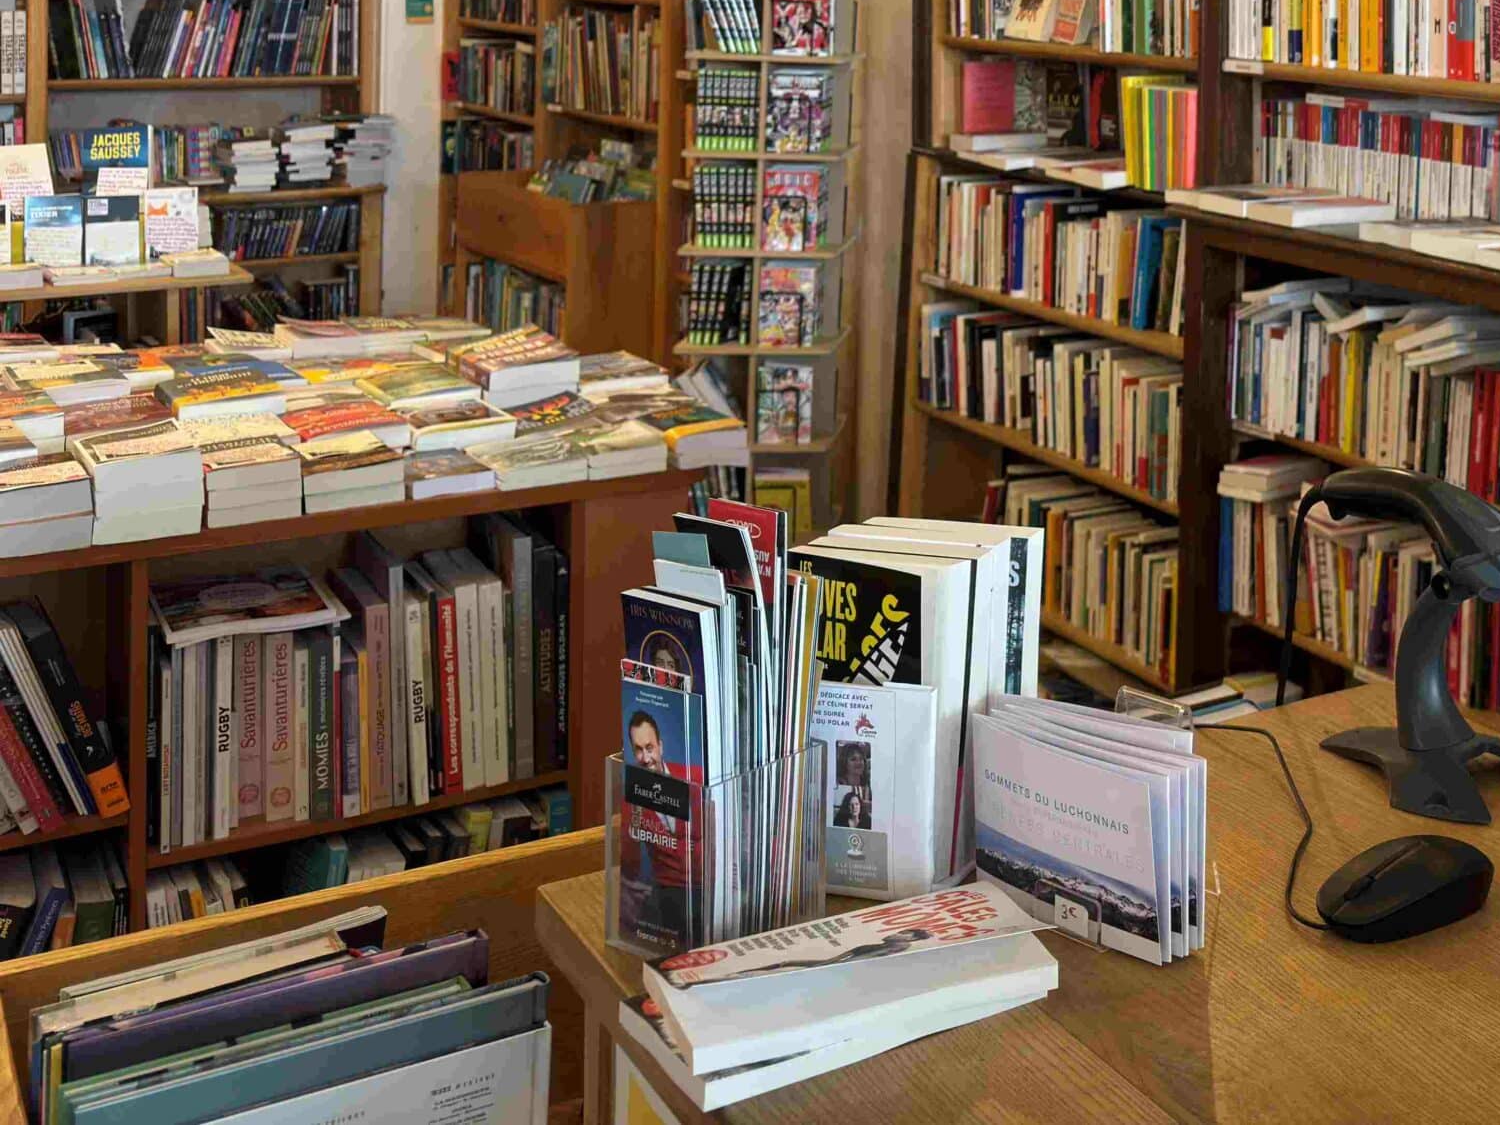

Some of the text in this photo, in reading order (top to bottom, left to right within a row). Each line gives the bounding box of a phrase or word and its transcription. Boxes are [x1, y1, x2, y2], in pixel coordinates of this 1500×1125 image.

[90, 144, 141, 160] SAUSSEY
[92, 131, 141, 149] JACQUES
[800, 560, 813, 575] LES
[441, 603, 454, 659] l'Humanité
[540, 627, 551, 693] ALTITUDES
[240, 640, 256, 749] Savanturières
[272, 642, 288, 753] Savanturières
[412, 679, 424, 725] RUGBY
[820, 691, 868, 701] DÉDICACE AVEC
[827, 700, 849, 709] CÉLINE
[850, 703, 873, 711] SERVAT
[218, 705, 230, 753] RUGBY
[445, 674, 457, 754] correspondants
[317, 731, 330, 790] MOMIES
[448, 755, 458, 774] Les
[634, 782, 681, 808] FABER-CASTELL
[984, 768, 1031, 799] SOMMETS
[1035, 792, 1049, 807] DU
[1054, 799, 1129, 835] LUCHONNAIS
[630, 828, 678, 851] LIBRAIRIE
[1061, 904, 1077, 920] 3€
